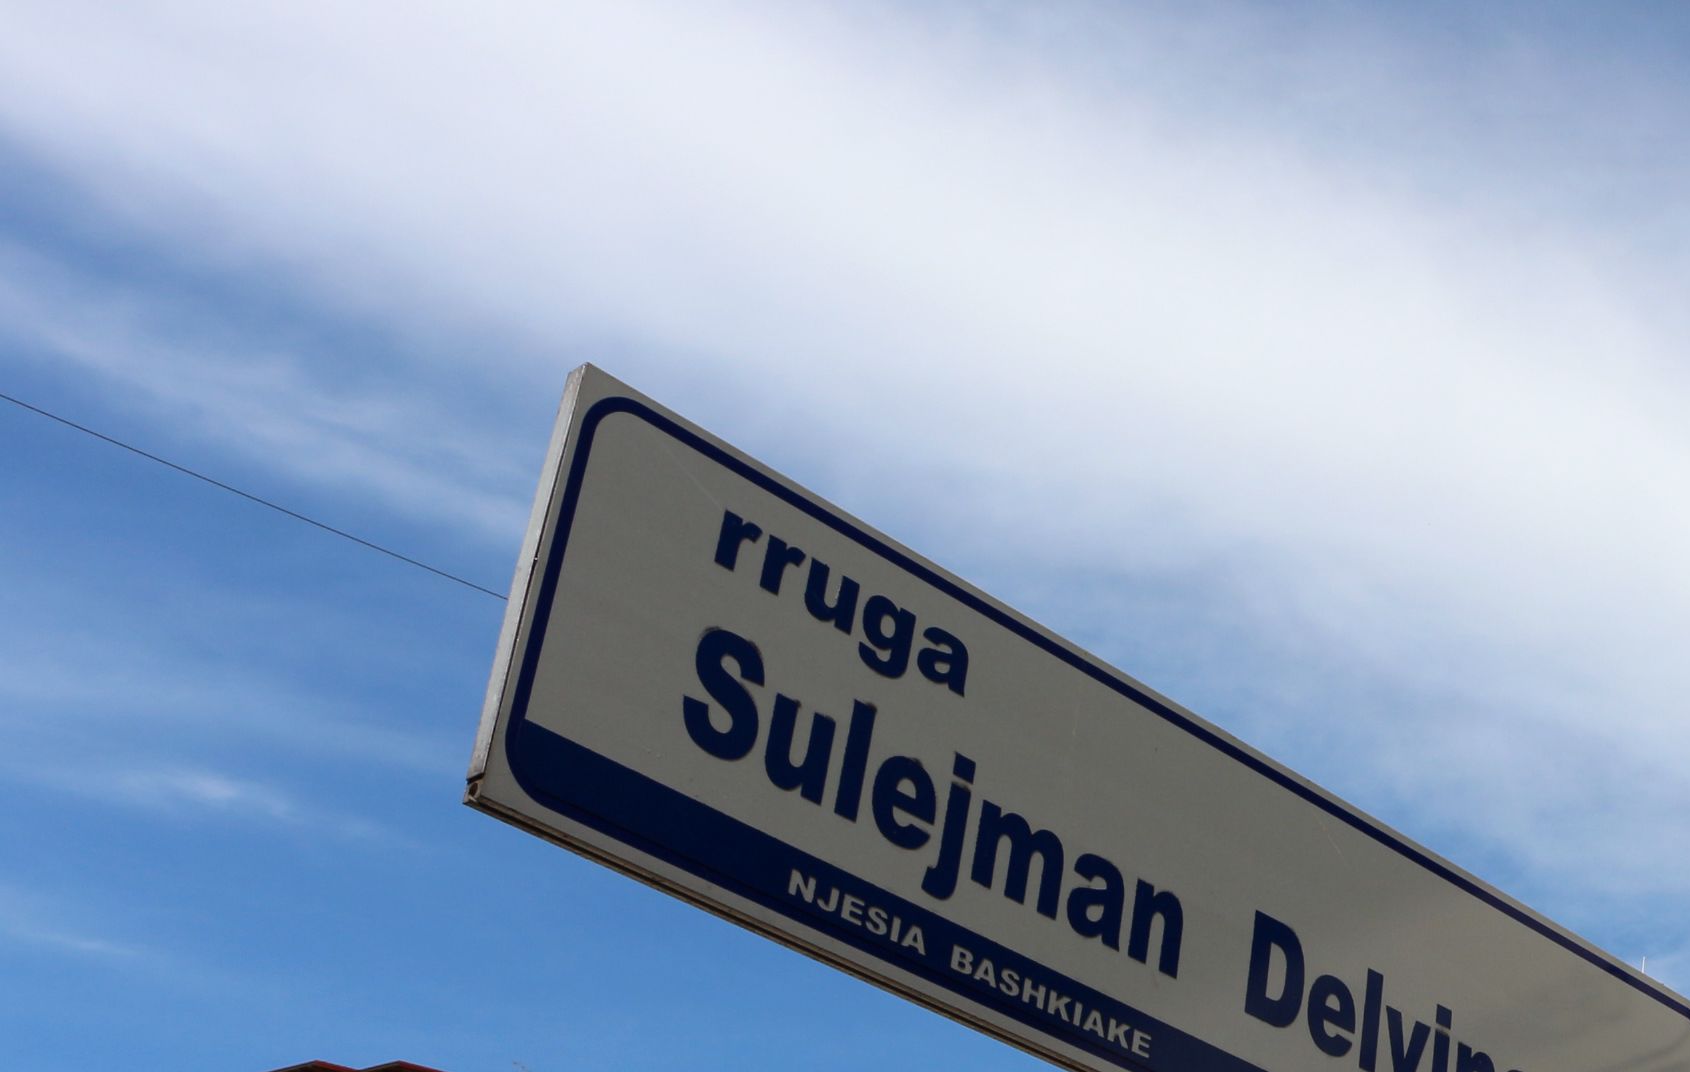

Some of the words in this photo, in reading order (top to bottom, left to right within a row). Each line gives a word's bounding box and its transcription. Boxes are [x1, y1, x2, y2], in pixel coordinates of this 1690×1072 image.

[714, 509, 970, 698] rruga
[682, 625, 1184, 980] Sulejman
[788, 869, 927, 956] NJESIA
[950, 945, 1152, 1058] BASHKIAKE
